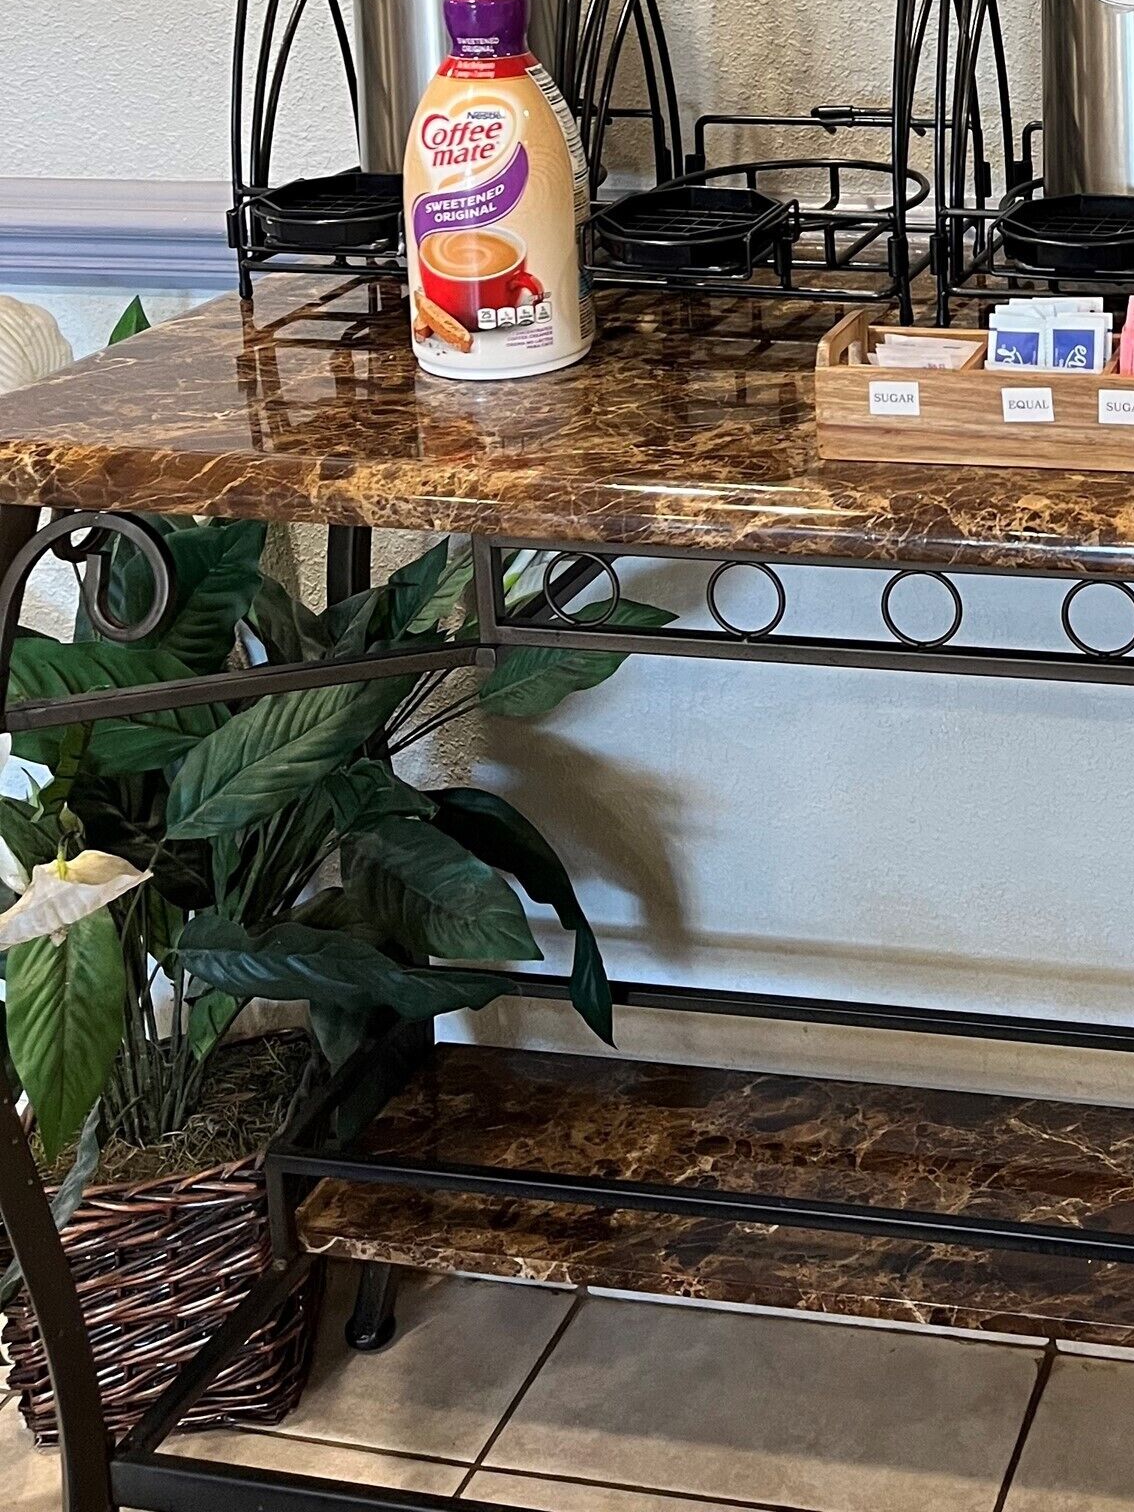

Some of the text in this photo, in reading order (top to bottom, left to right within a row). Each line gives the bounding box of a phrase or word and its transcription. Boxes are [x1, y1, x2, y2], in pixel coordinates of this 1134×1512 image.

[421, 113, 503, 150] Coffee
[432, 142, 496, 167] mate
[425, 184, 505, 214] SWEETENED
[434, 202, 497, 223] ORIGINAL
[874, 393, 914, 403] SUGAR
[1008, 399, 1050, 410] EQUAL
